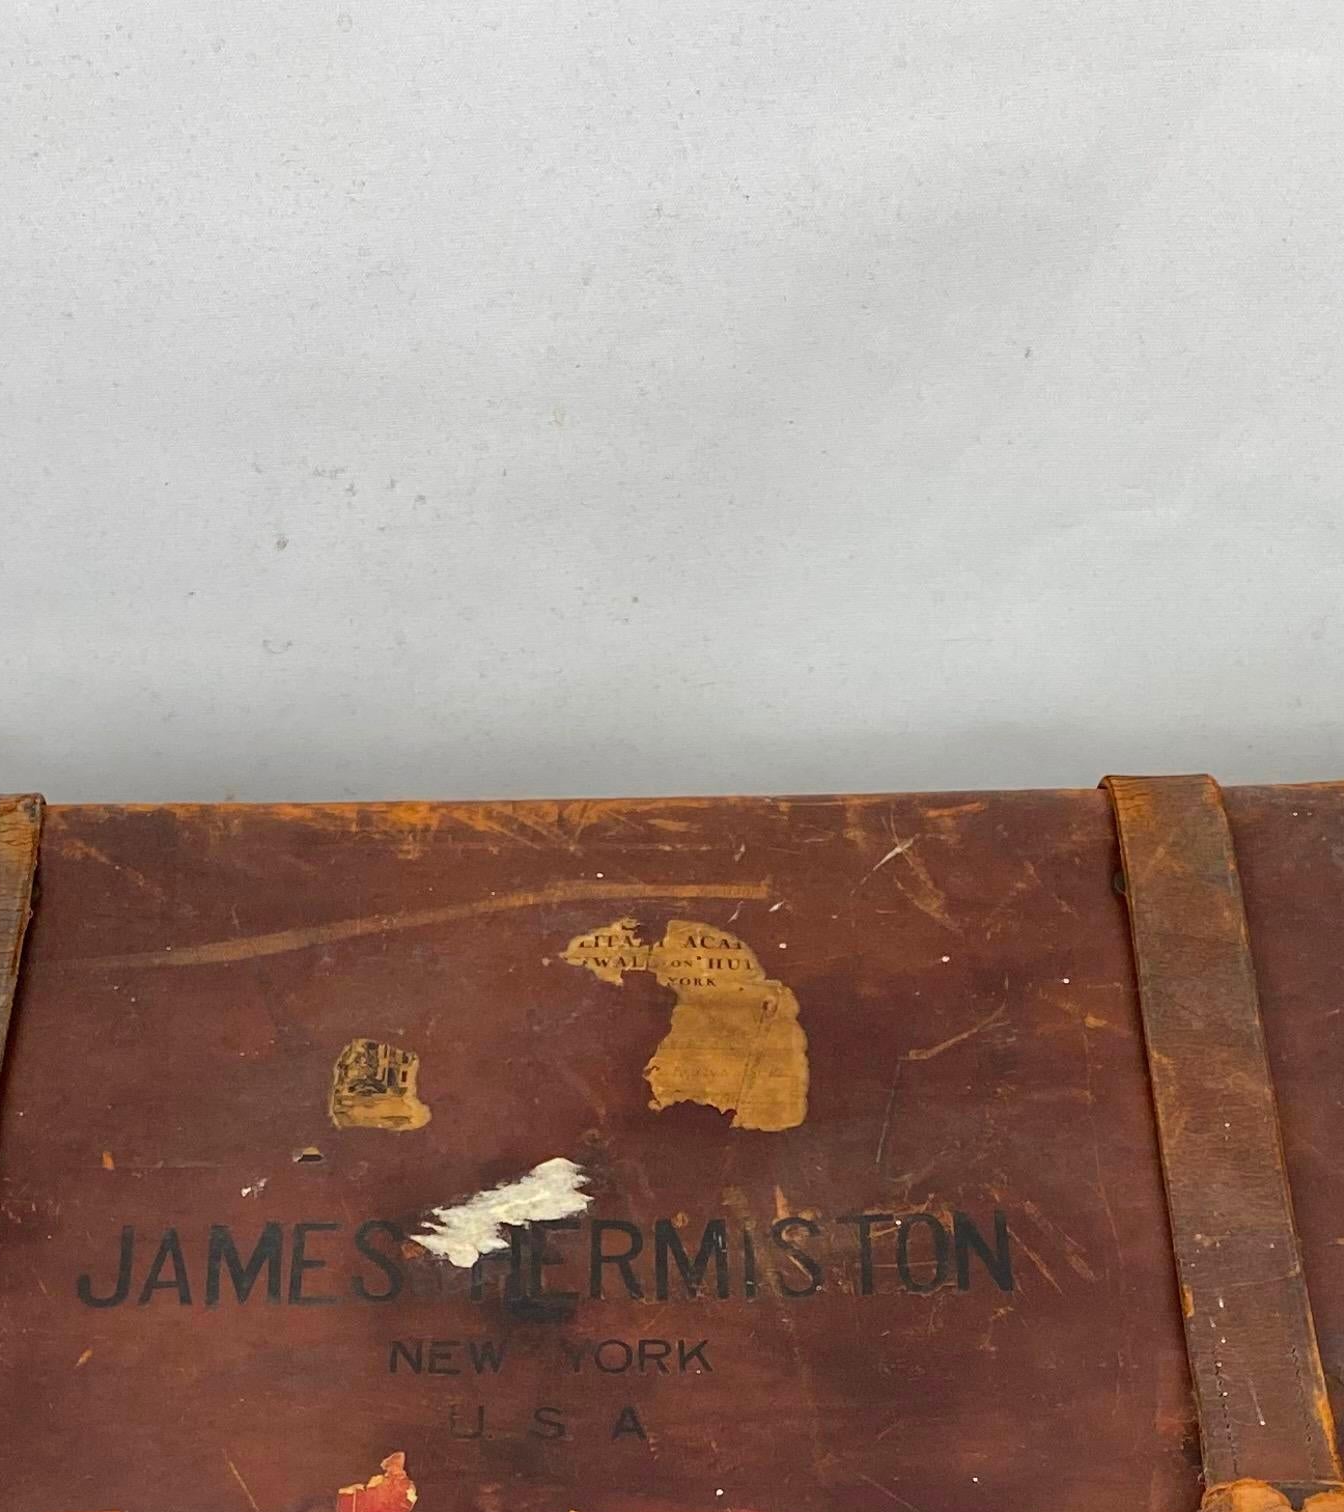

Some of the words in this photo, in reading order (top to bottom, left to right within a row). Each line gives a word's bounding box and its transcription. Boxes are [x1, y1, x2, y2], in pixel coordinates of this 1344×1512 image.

[77, 1220, 407, 1309] JAMES
[389, 1339, 505, 1376] NEW
[560, 1338, 713, 1375] YORK
